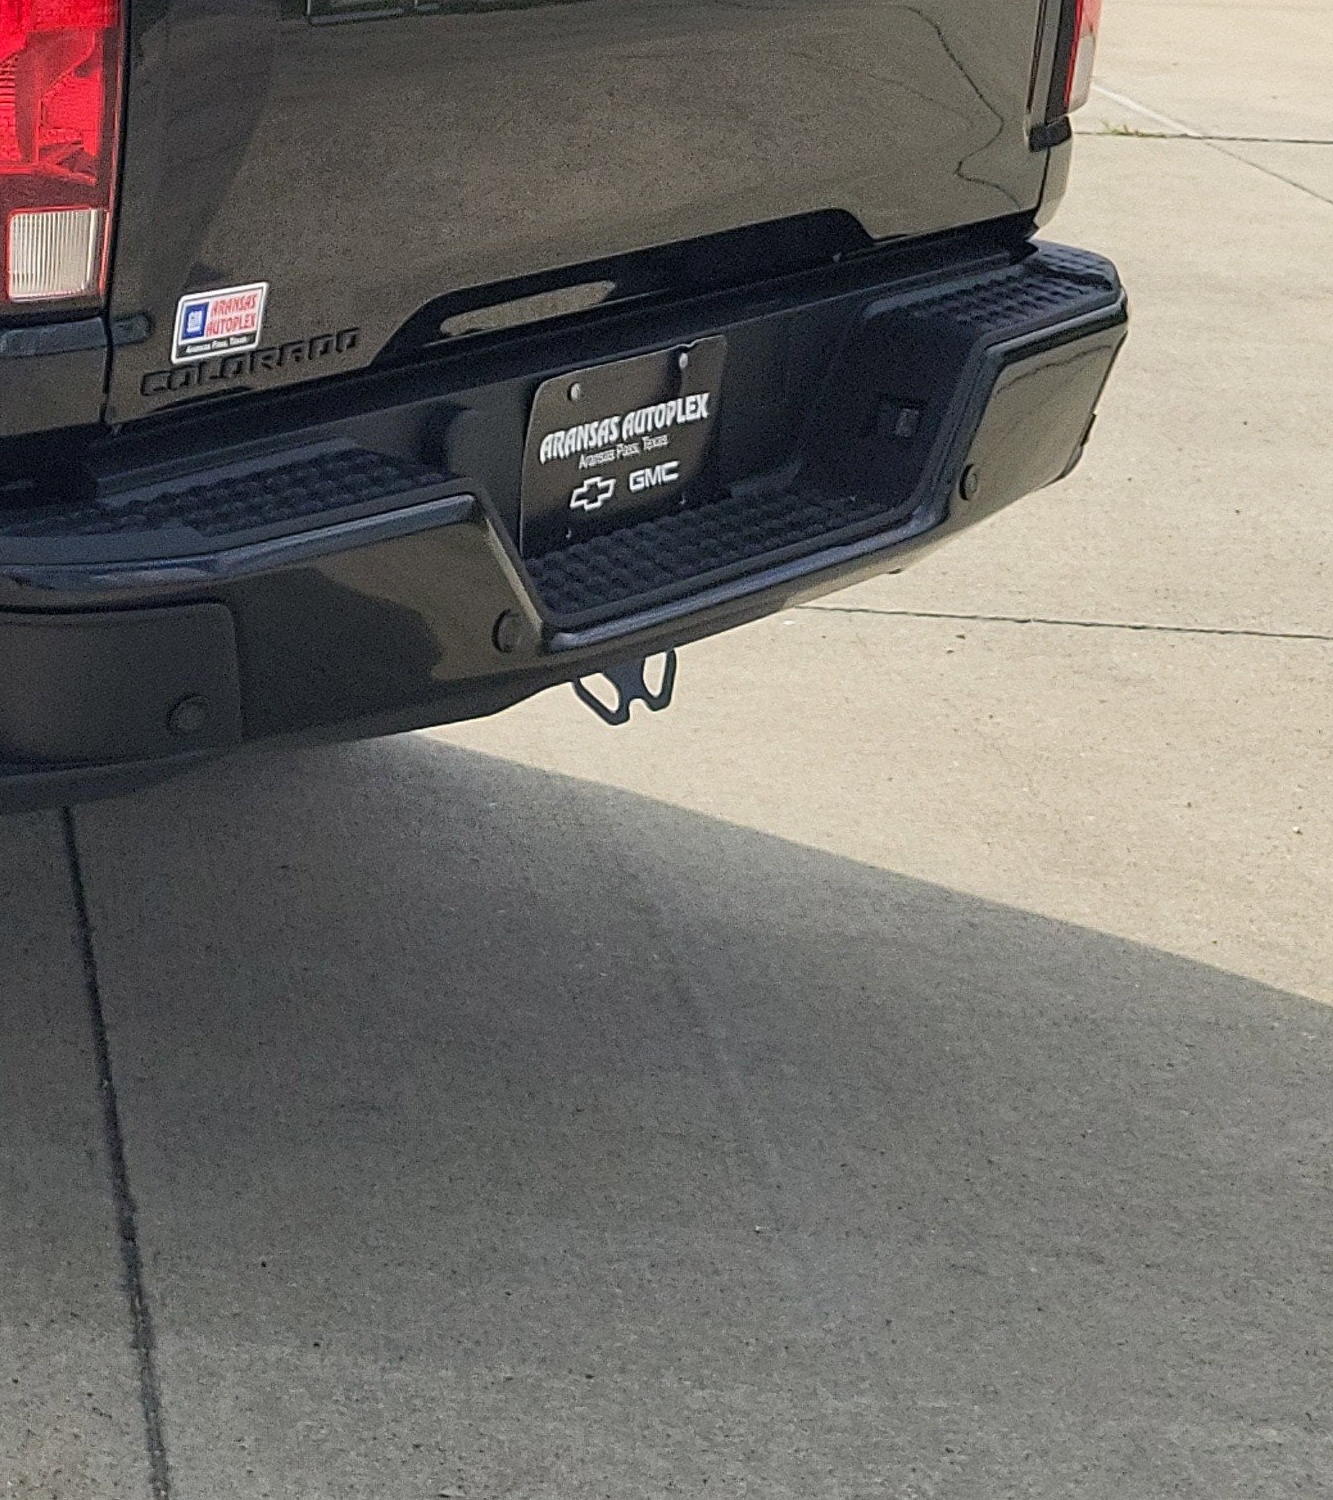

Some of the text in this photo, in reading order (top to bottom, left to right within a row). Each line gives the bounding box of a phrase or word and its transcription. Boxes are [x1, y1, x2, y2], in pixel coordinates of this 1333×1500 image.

[210, 293, 258, 316] ARANSAS
[206, 313, 257, 337] AUTOPLEX
[140, 327, 361, 397] COLORADO
[539, 392, 711, 465] ARANSAS AUTOPLEX
[628, 460, 680, 493] GMC
